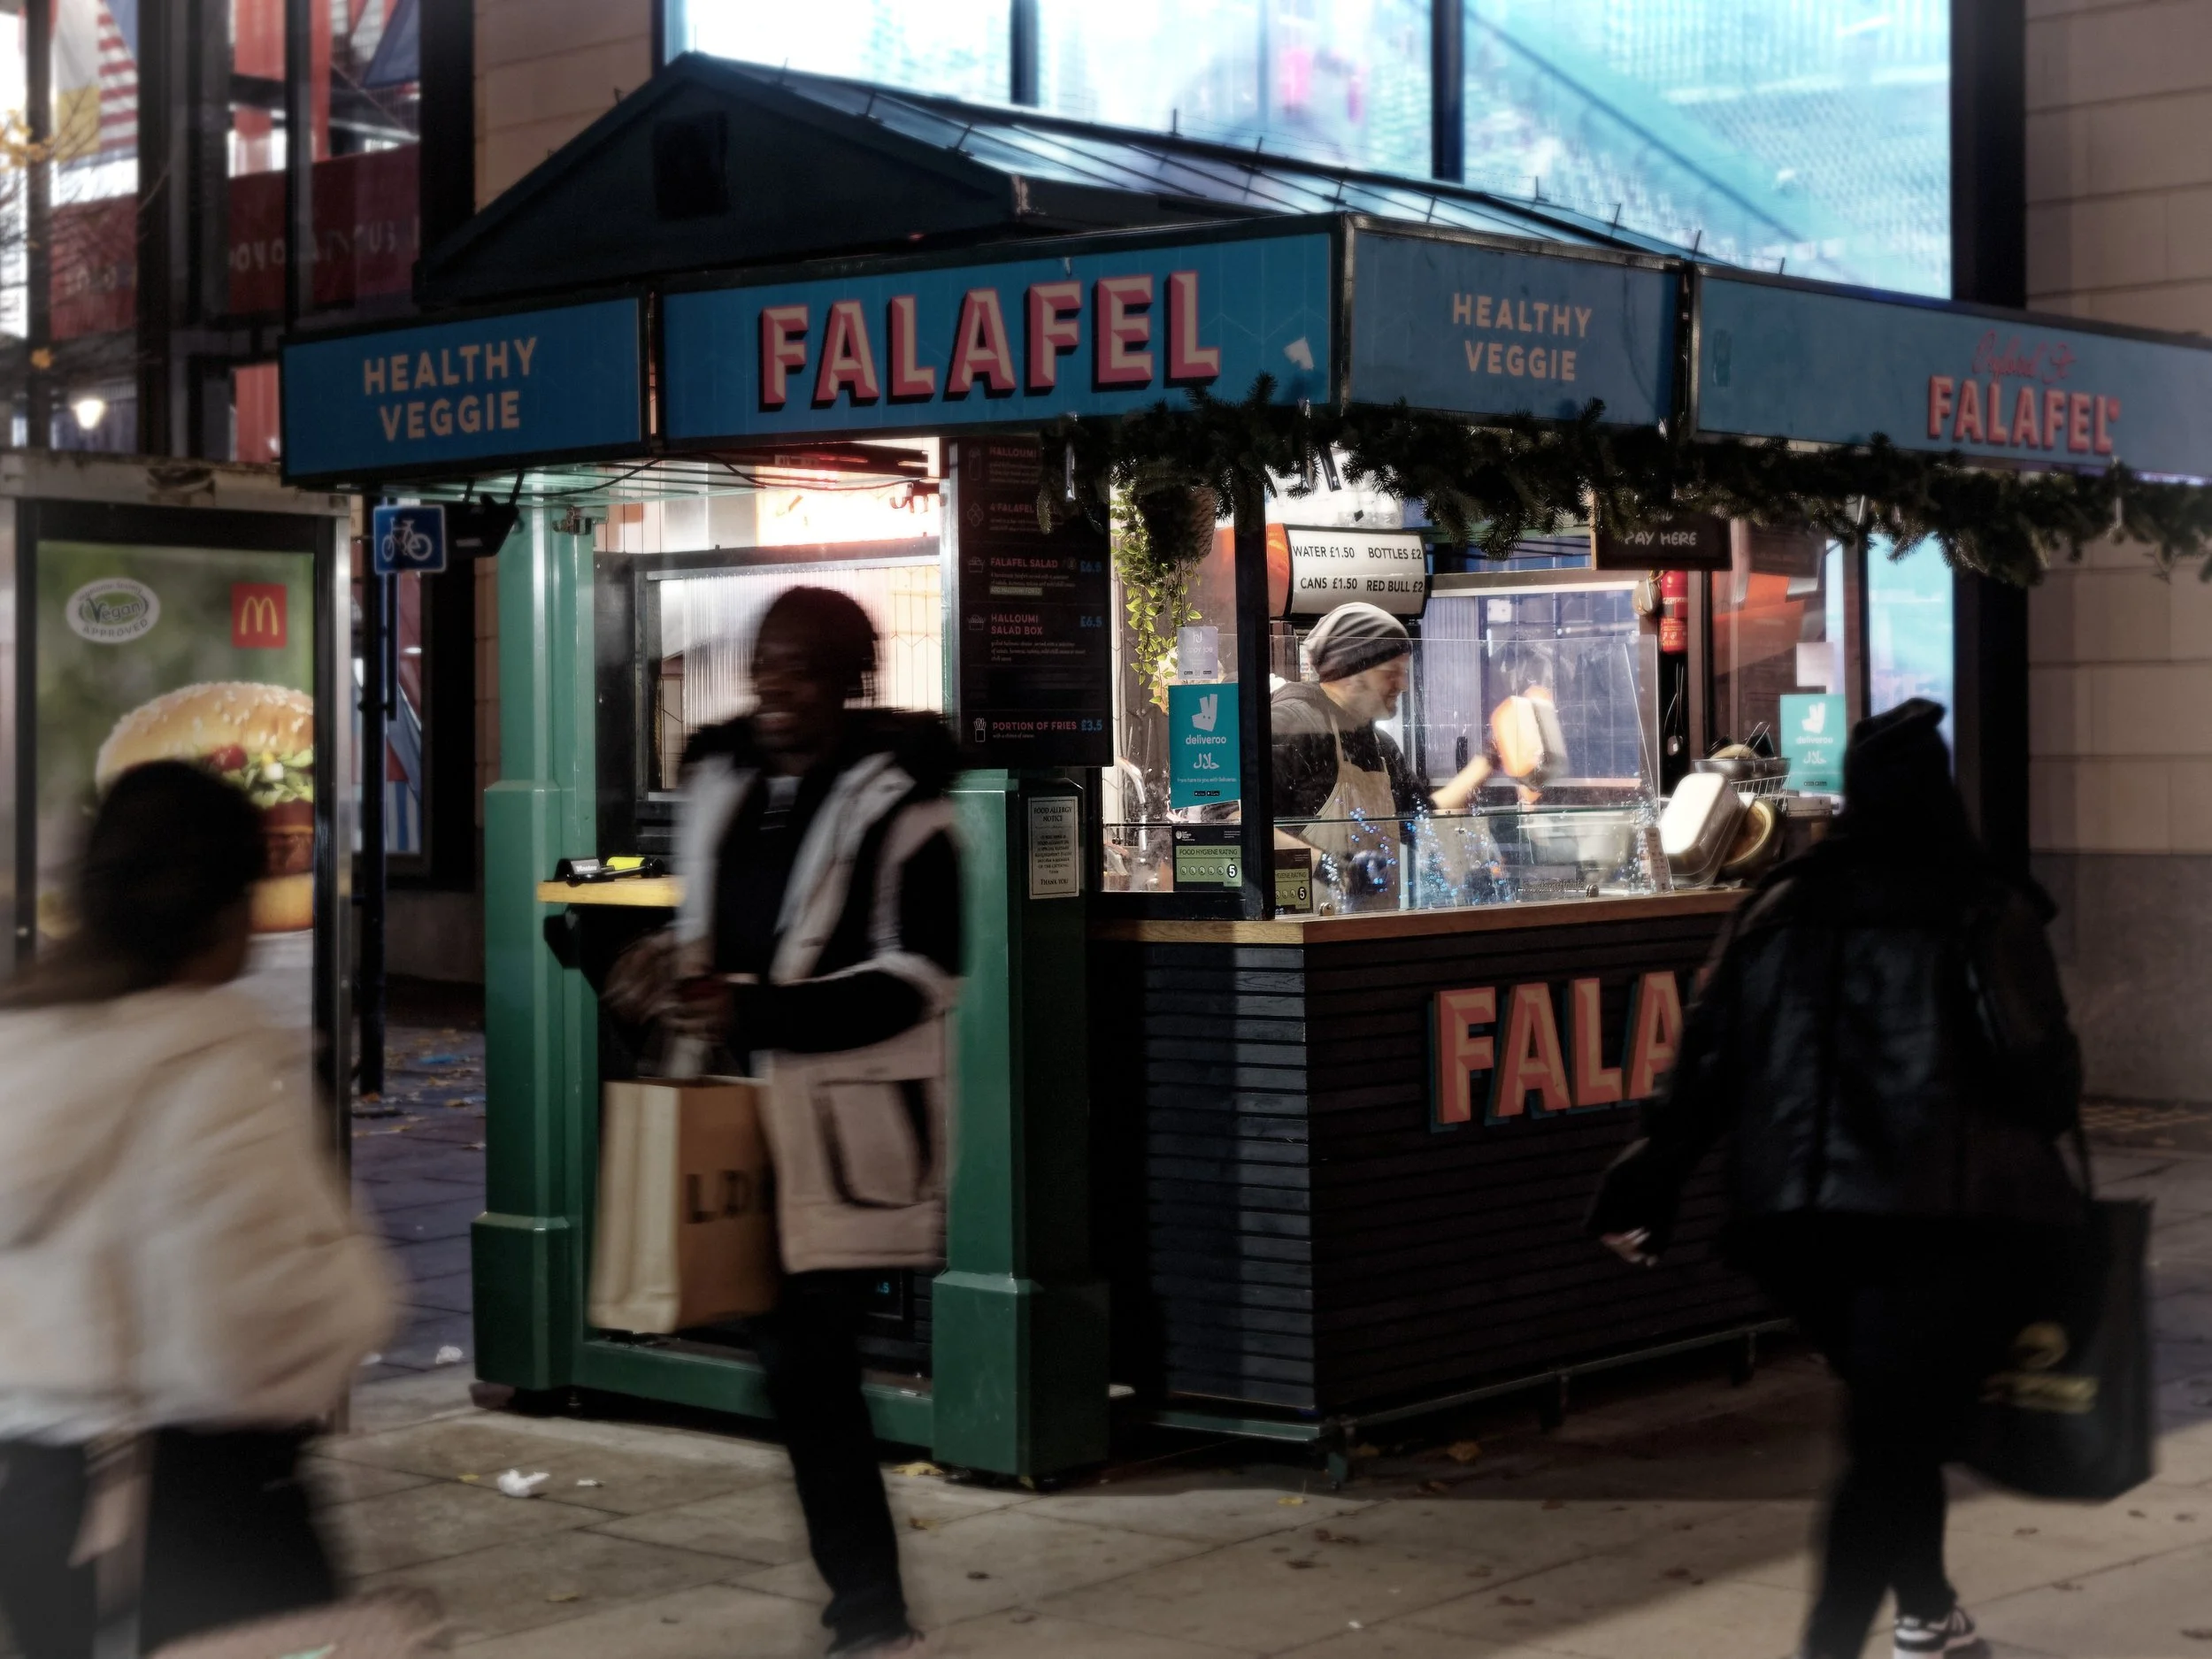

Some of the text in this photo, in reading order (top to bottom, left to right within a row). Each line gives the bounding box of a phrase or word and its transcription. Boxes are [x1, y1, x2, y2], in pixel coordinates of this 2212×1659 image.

[1452, 292, 1592, 338] HEALTHY
[758, 270, 1219, 412] FALAFEL
[364, 336, 537, 396] HEALTHY
[1464, 340, 1577, 382] VEGGIE
[380, 390, 520, 442] VEGGIE
[1927, 375, 2113, 454] FALAFEL
[1624, 531, 1697, 546] PAY HERE
[1293, 545, 1355, 558] WATER £1.50
[1368, 547, 1423, 560] BOTTLES £2
[990, 557, 1058, 568] FALAFEL SALAD
[1301, 577, 1357, 589] CANS £1.50
[1366, 580, 1424, 593] RED BULL £2
[87, 597, 141, 624] Vegan
[991, 613, 1039, 624] HALLOUMI
[83, 618, 149, 638] APPROVED
[991, 626, 1043, 635] SALAD BOX
[992, 720, 1077, 731] PORTION OF FRIES
[1080, 718, 1103, 732] £3.5
[1185, 733, 1227, 745] deliveroo
[1795, 735, 1833, 744] deliveroo
[1193, 752, 1220, 770] حلال
[1228, 864, 1237, 878] 5
[1299, 887, 1305, 899] 5
[1427, 971, 1708, 1133] FALA
